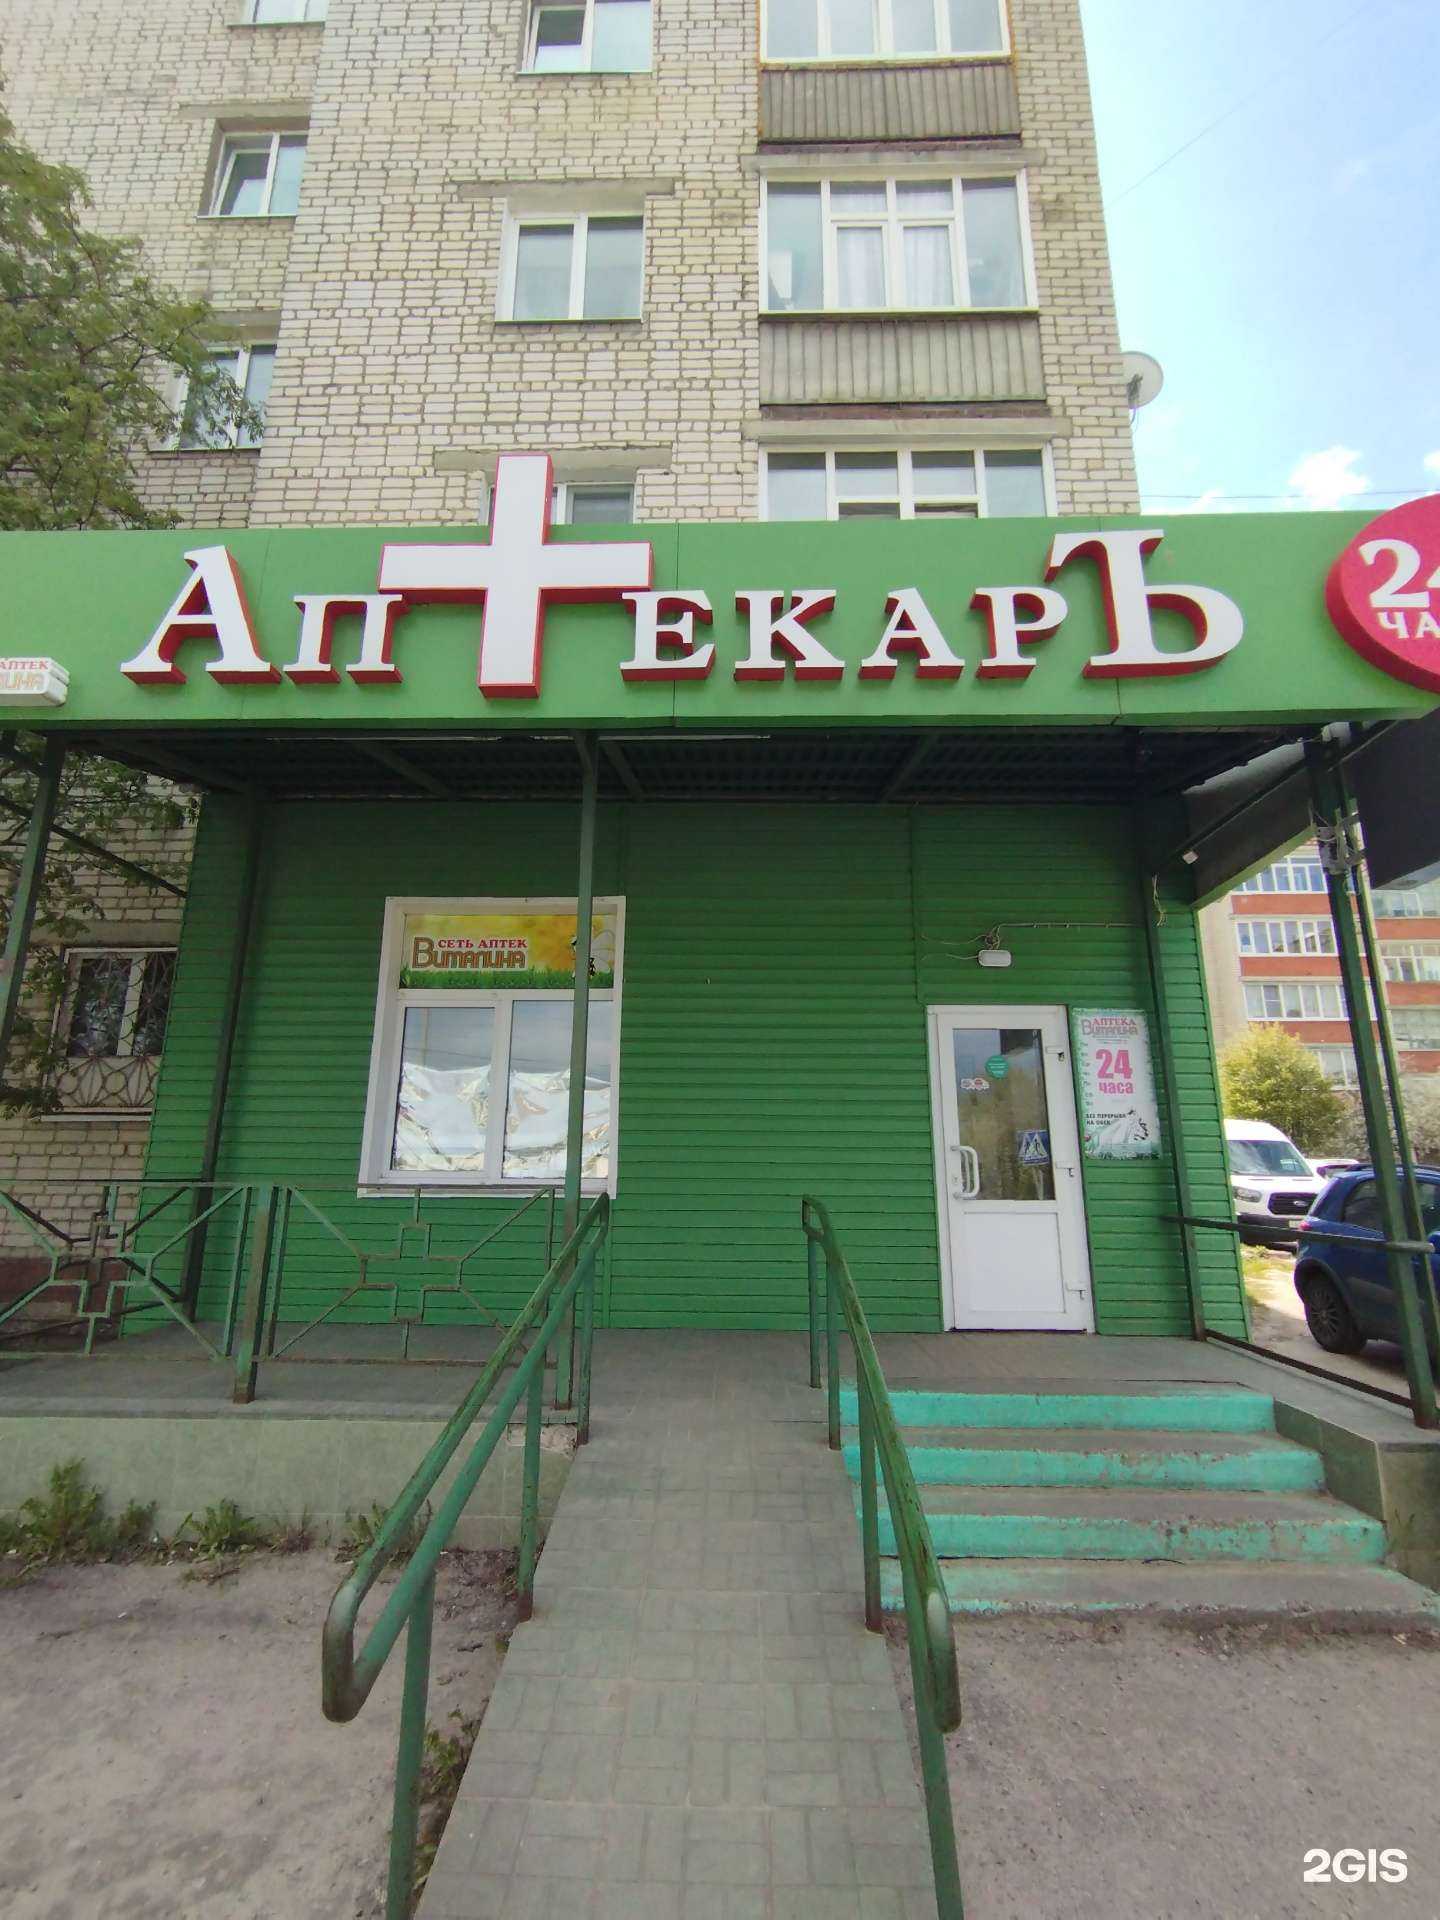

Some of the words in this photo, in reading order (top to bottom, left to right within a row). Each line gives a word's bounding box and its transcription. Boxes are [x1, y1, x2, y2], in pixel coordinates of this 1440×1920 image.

[438, 939, 474, 949] СЕТЬ
[478, 939, 528, 948] АПТЕК
[1092, 1017, 1137, 1026] АПТЕКА
[1095, 1049, 1133, 1079] 24
[1098, 1082, 1134, 1095] часа
